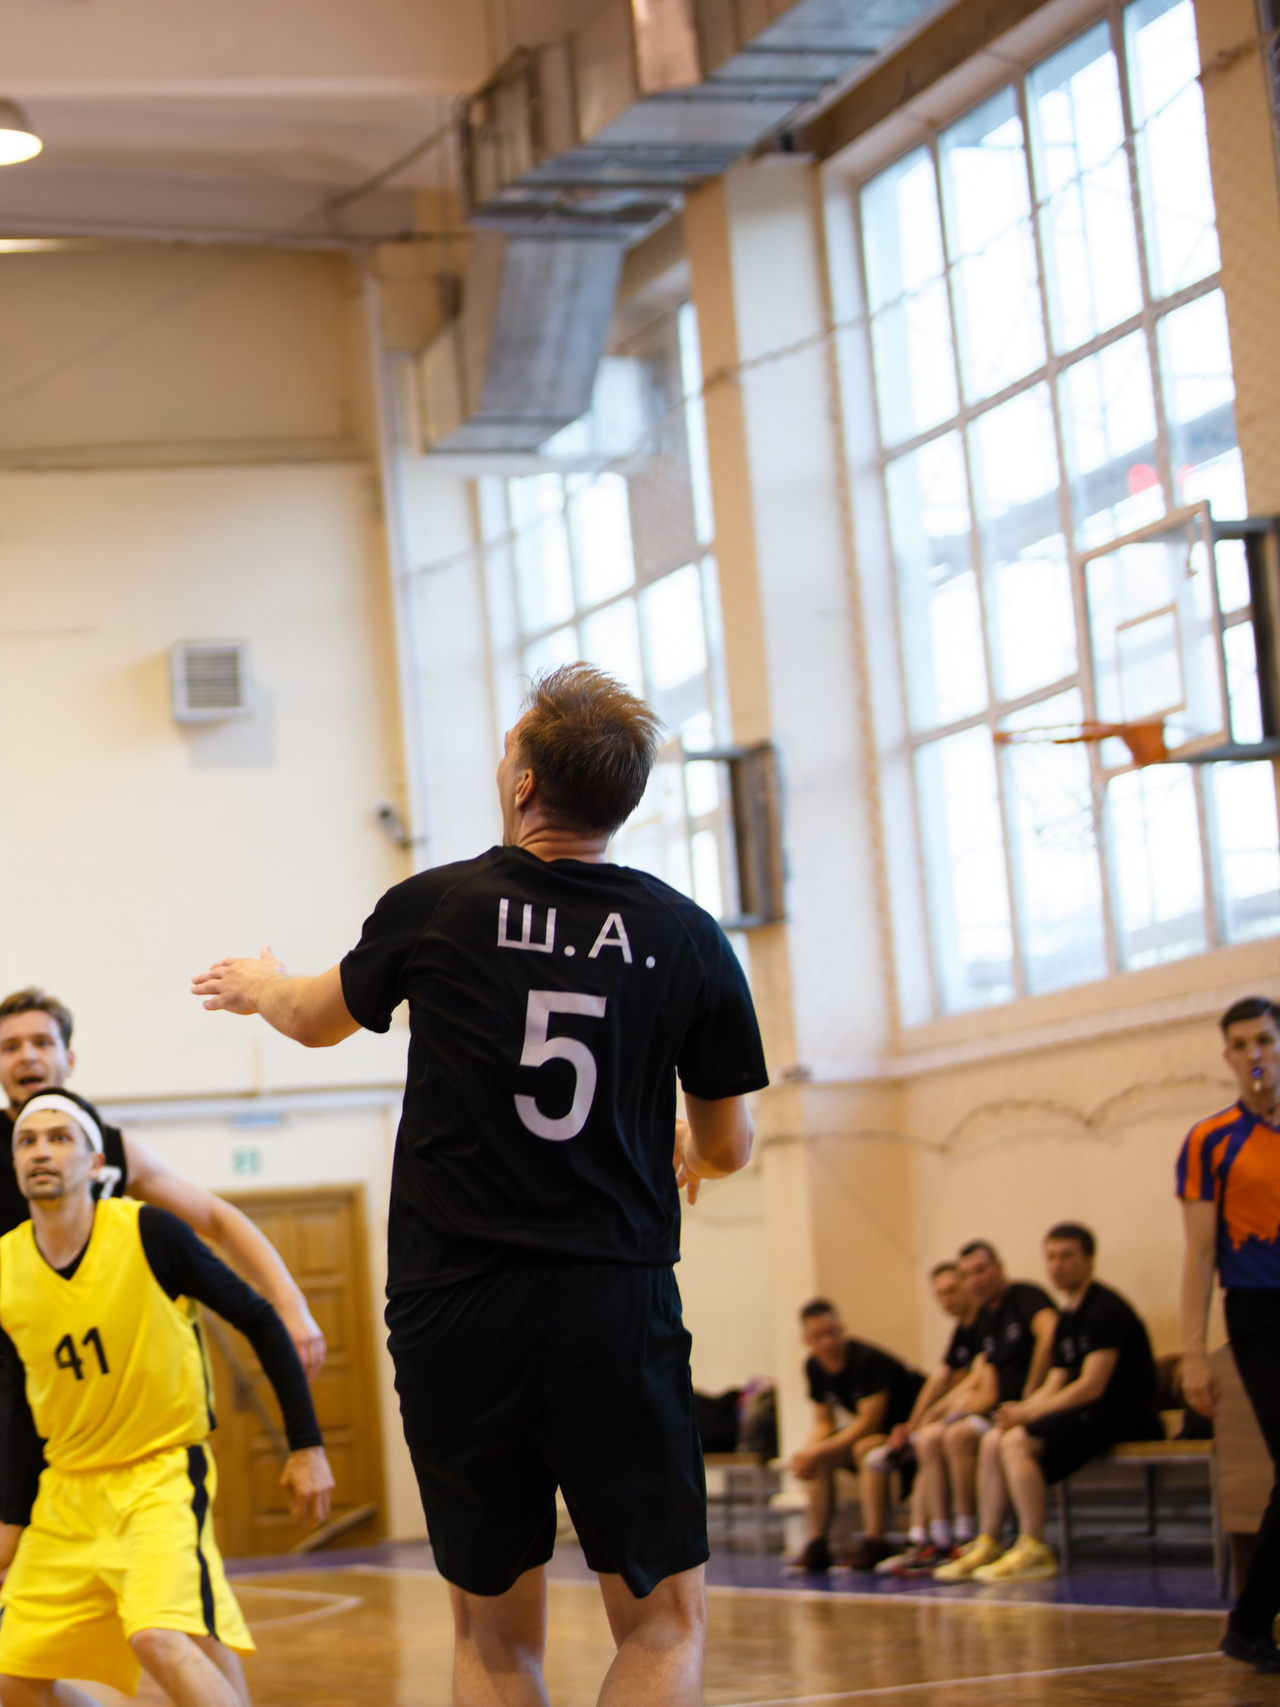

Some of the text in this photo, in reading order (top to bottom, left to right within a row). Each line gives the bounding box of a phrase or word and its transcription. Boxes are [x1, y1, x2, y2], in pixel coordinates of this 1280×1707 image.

[497, 898, 656, 969] Ш.А.
[514, 989, 607, 1142] 5
[53, 1326, 109, 1381] 41
